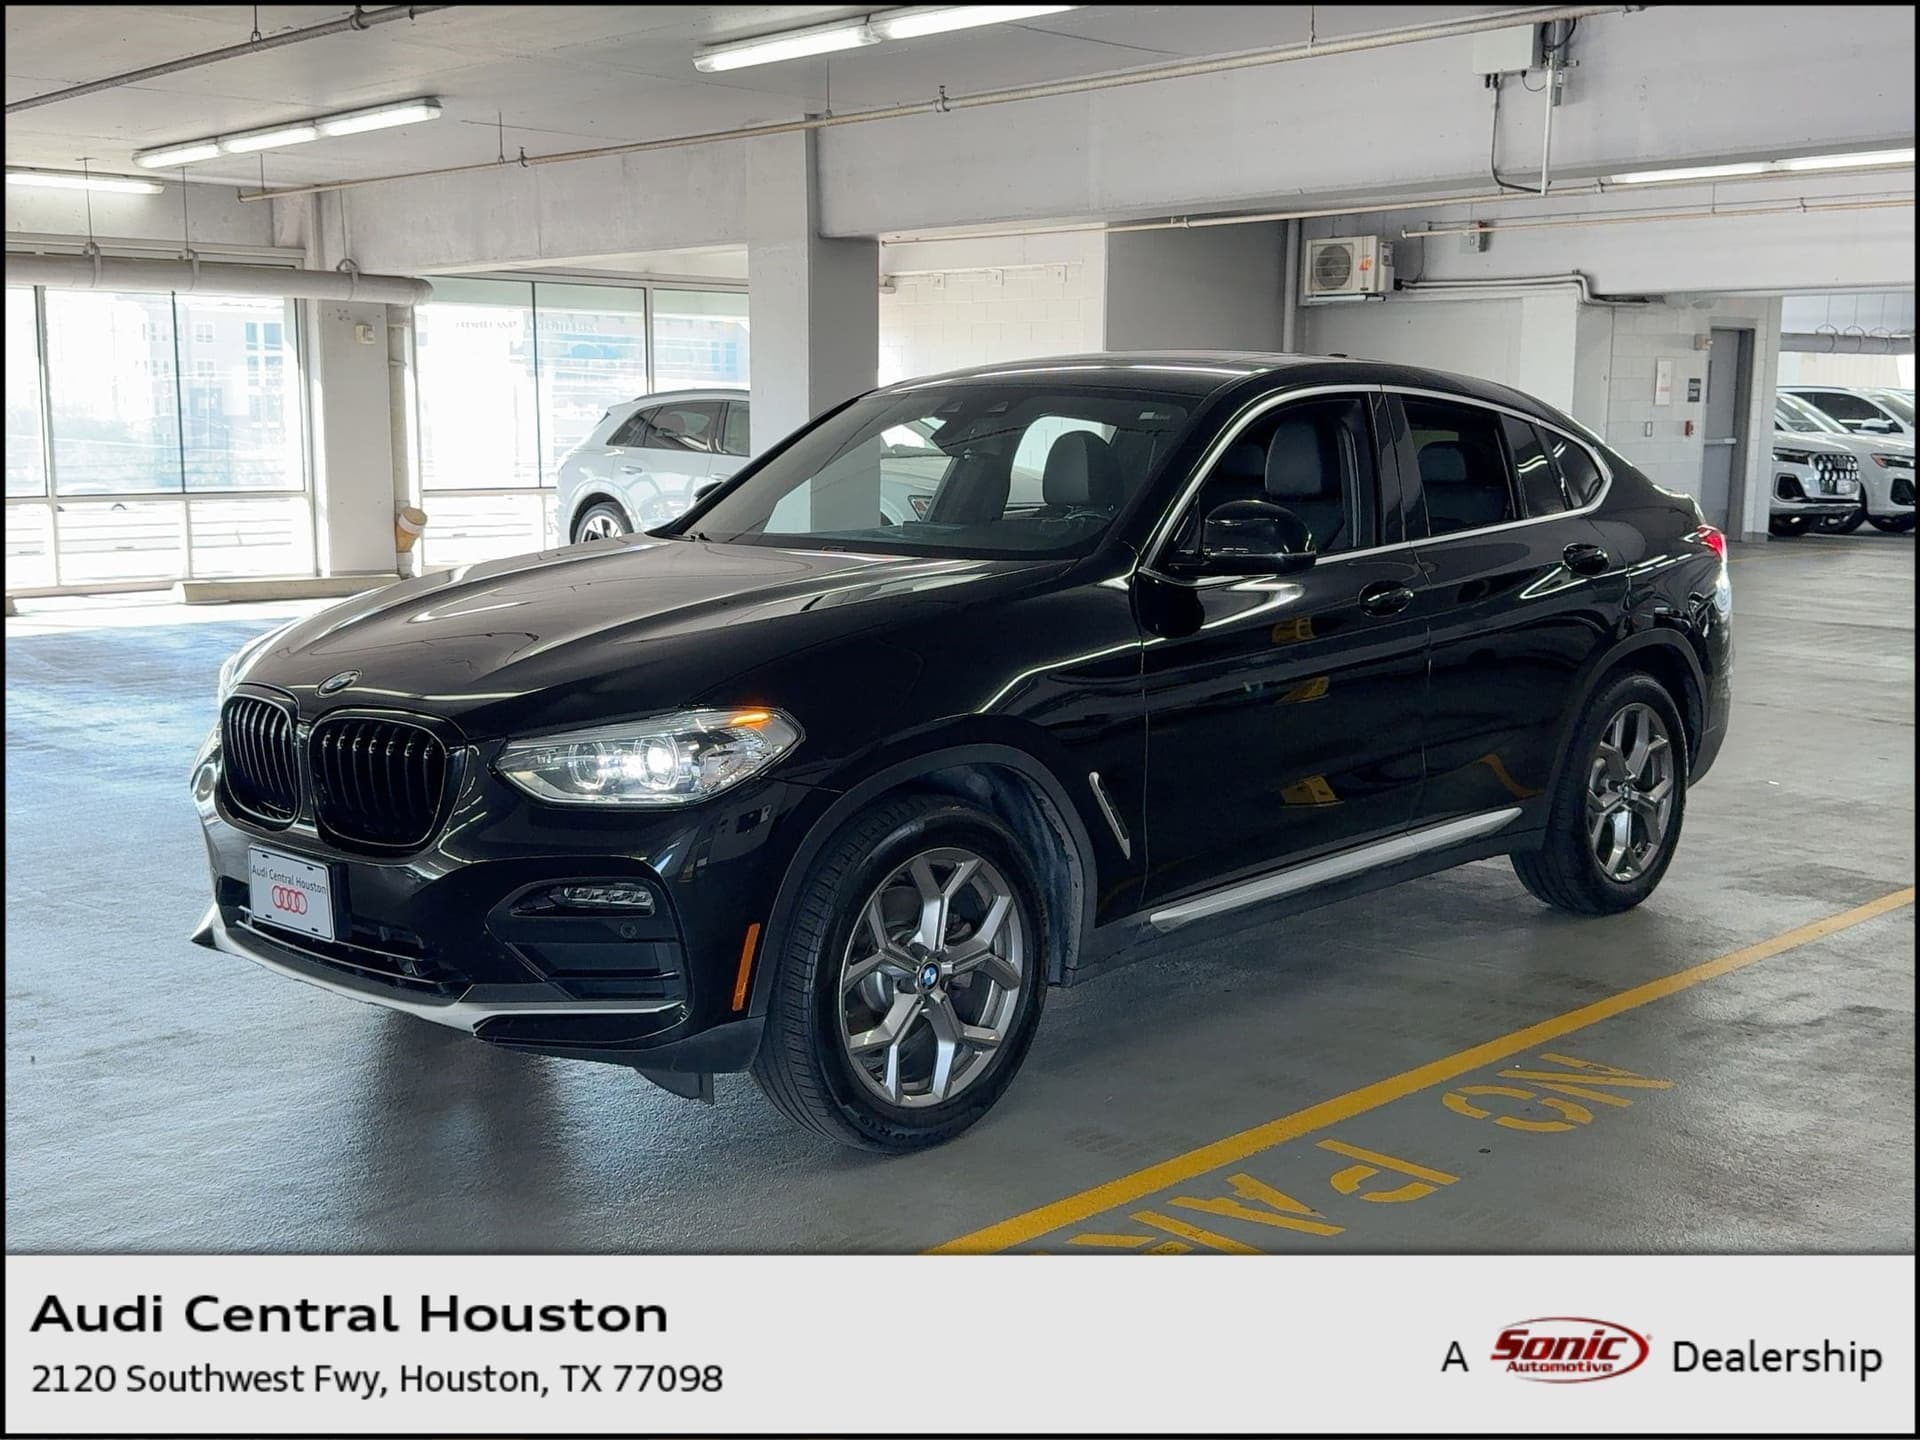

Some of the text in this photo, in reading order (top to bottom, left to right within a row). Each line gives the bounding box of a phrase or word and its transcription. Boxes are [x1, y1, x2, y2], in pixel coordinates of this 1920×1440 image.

[252, 864, 327, 895] Audi Central Houston
[1441, 1052, 1676, 1133] NO
